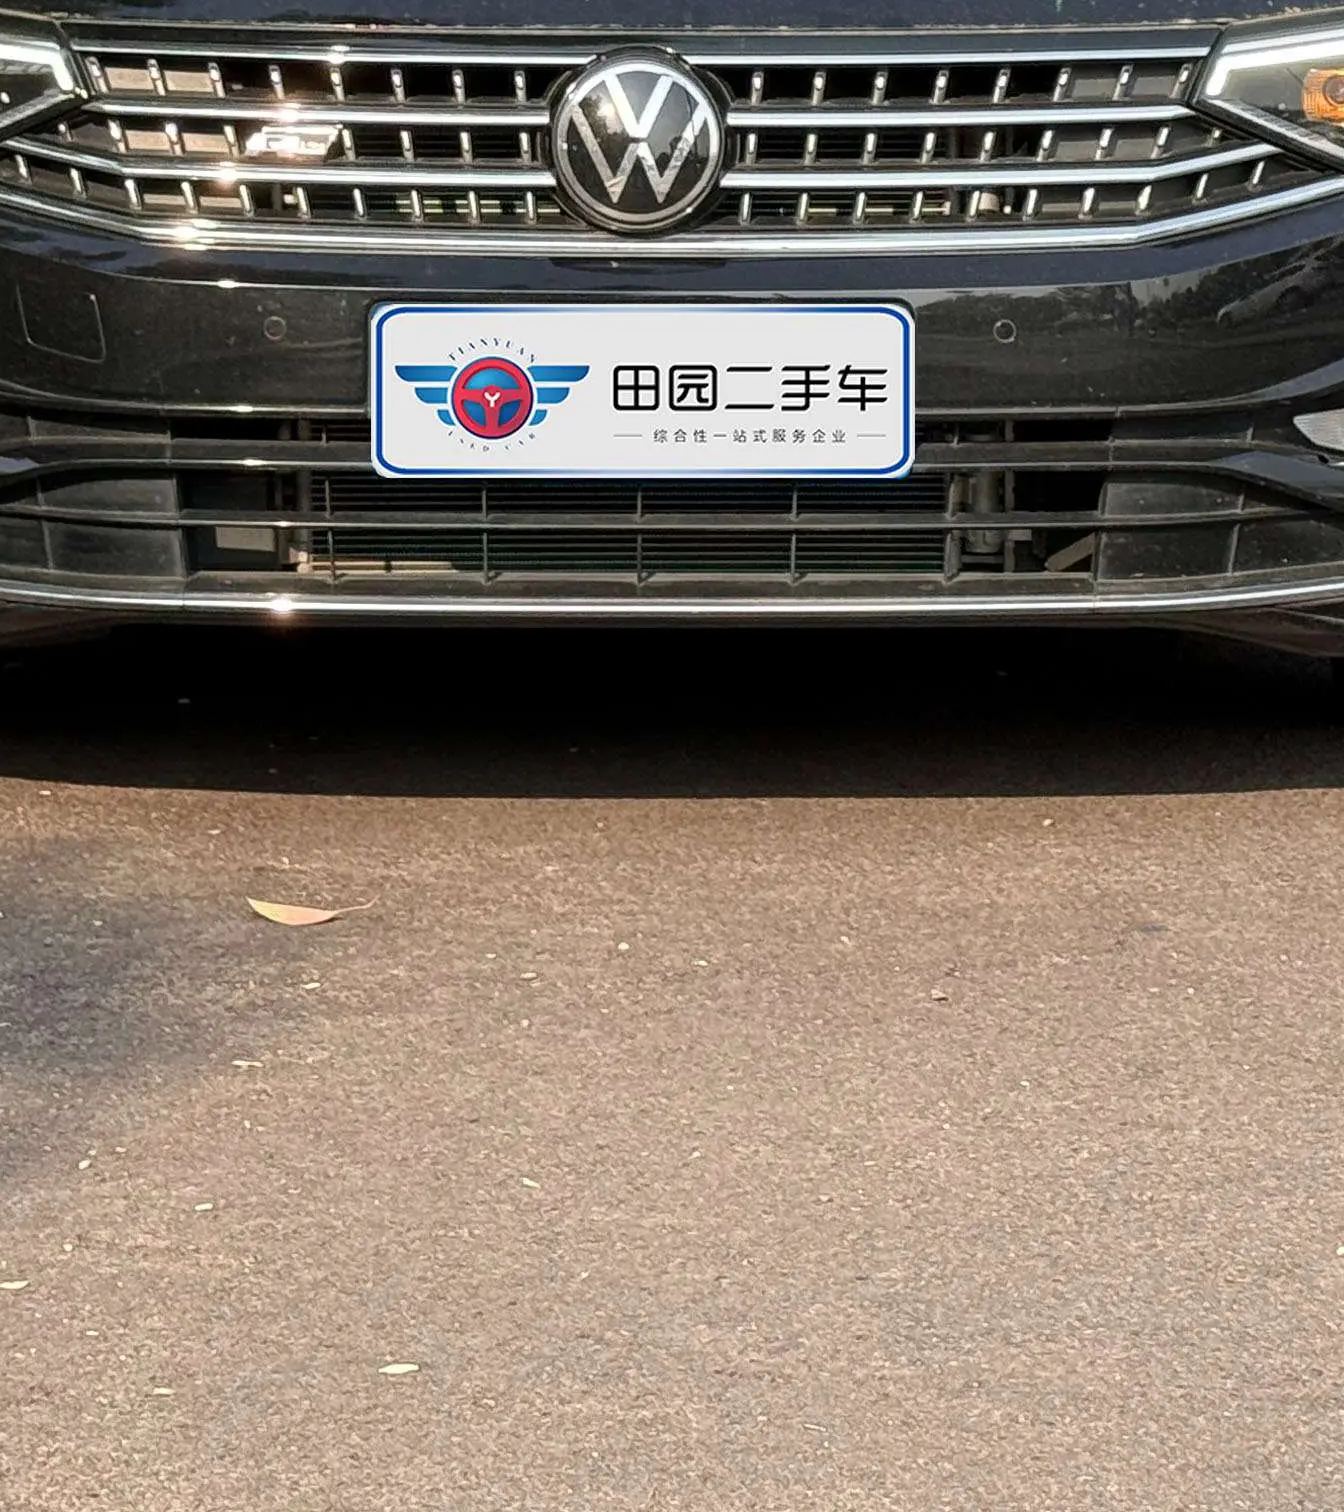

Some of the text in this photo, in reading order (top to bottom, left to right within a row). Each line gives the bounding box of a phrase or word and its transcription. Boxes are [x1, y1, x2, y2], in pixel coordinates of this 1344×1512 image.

[612, 363, 889, 412] 田园二手车
[653, 428, 846, 444] 综合性一站式服务企业
